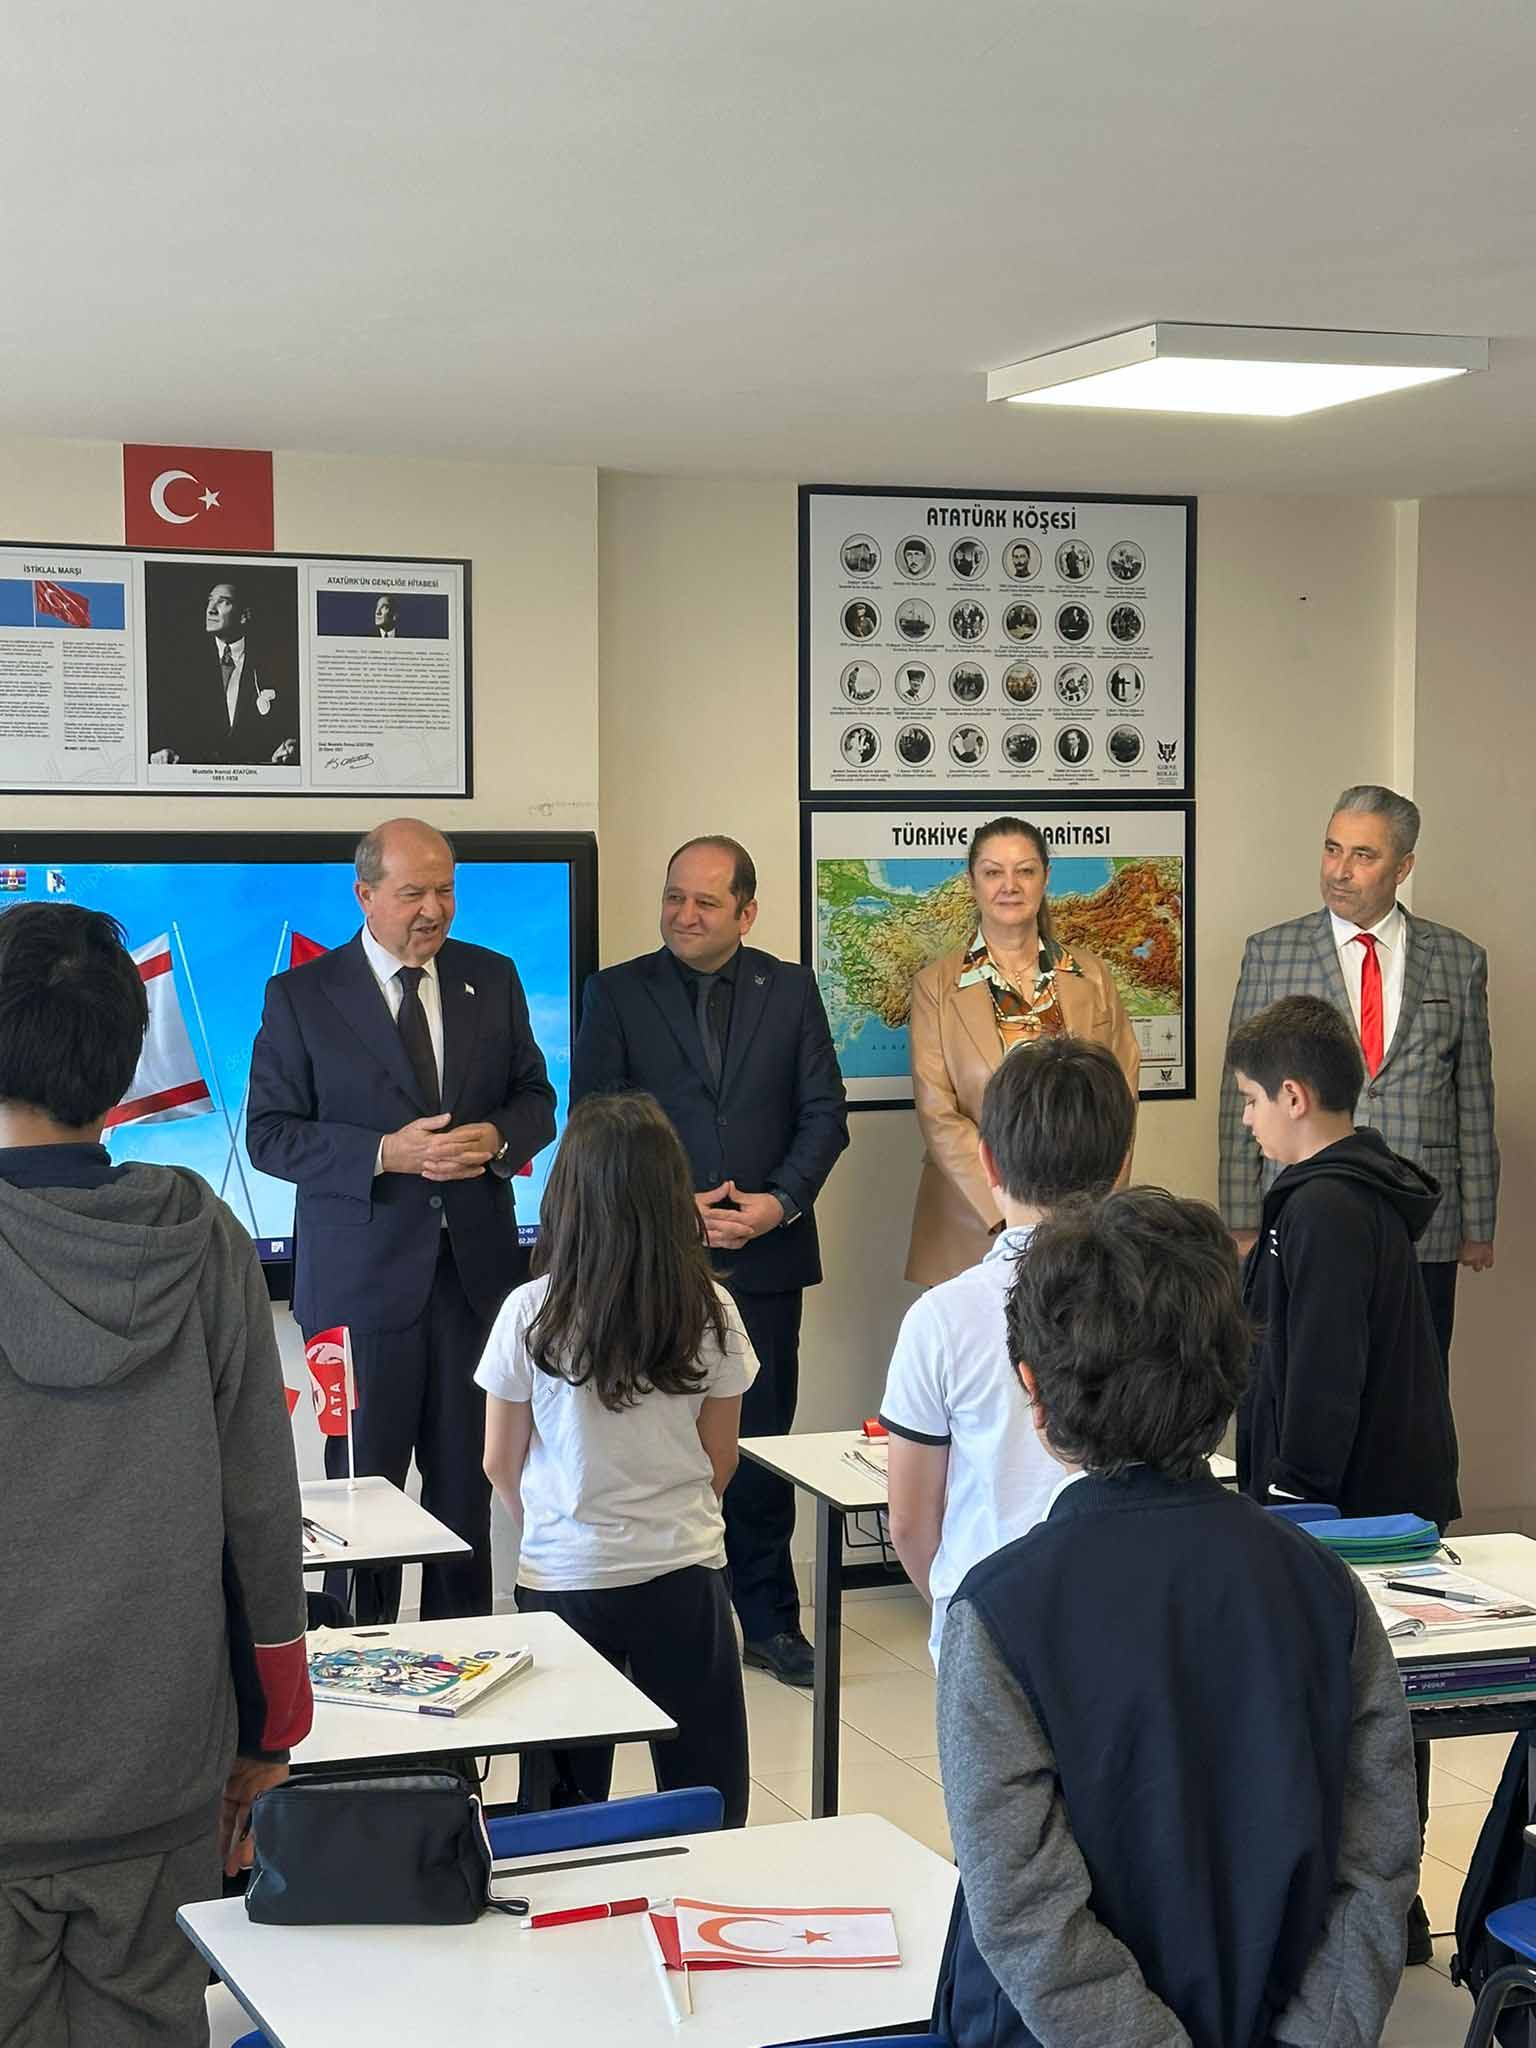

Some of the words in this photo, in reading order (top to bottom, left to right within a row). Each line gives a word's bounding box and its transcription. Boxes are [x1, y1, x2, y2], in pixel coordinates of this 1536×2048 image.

[927, 504, 1007, 528] ATATÜRK
[1013, 505, 1077, 535] KÖŞESİ
[23, 564, 56, 574] İSTİKLAL
[58, 567, 82, 576] MARŞI
[892, 821, 968, 846] TÜRKİYE
[1038, 821, 1110, 845] ARİTASI
